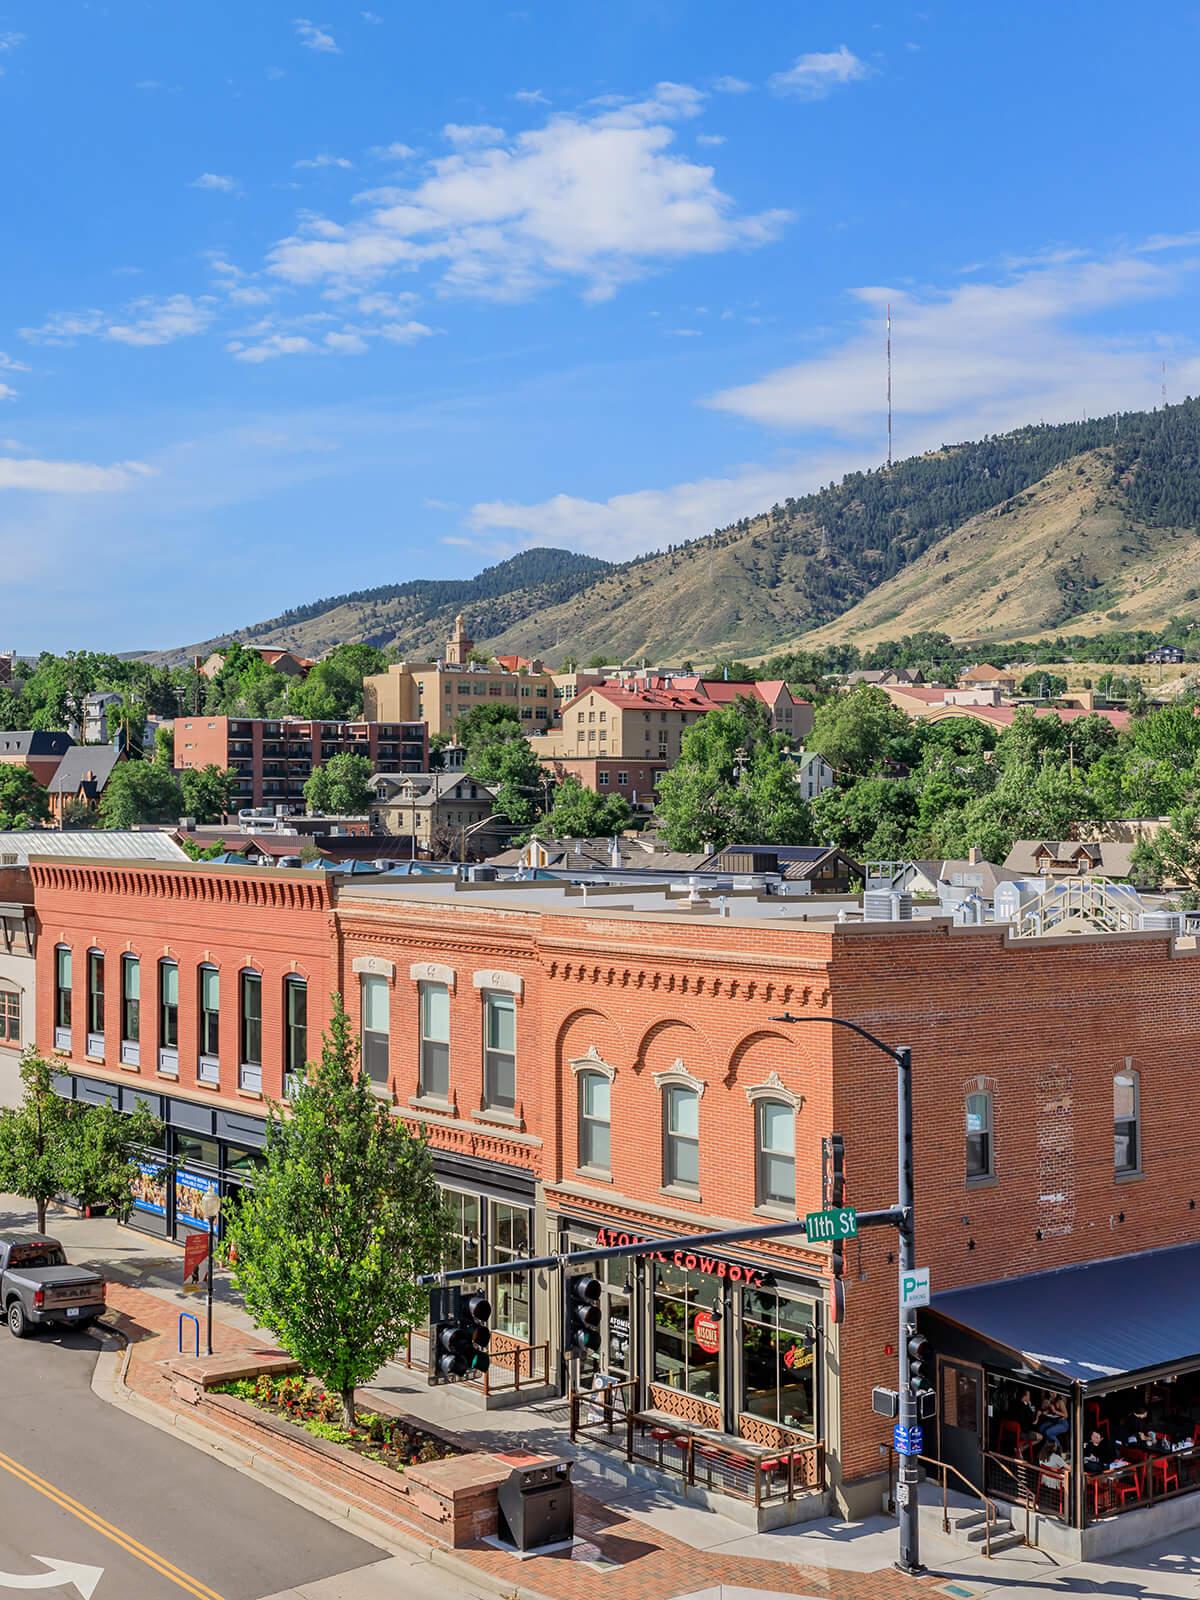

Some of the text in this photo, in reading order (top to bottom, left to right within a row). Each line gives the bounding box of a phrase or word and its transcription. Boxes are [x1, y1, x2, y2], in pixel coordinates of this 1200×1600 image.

[808, 1211, 855, 1238] 11th St
[673, 1250, 755, 1285] COWBOY
